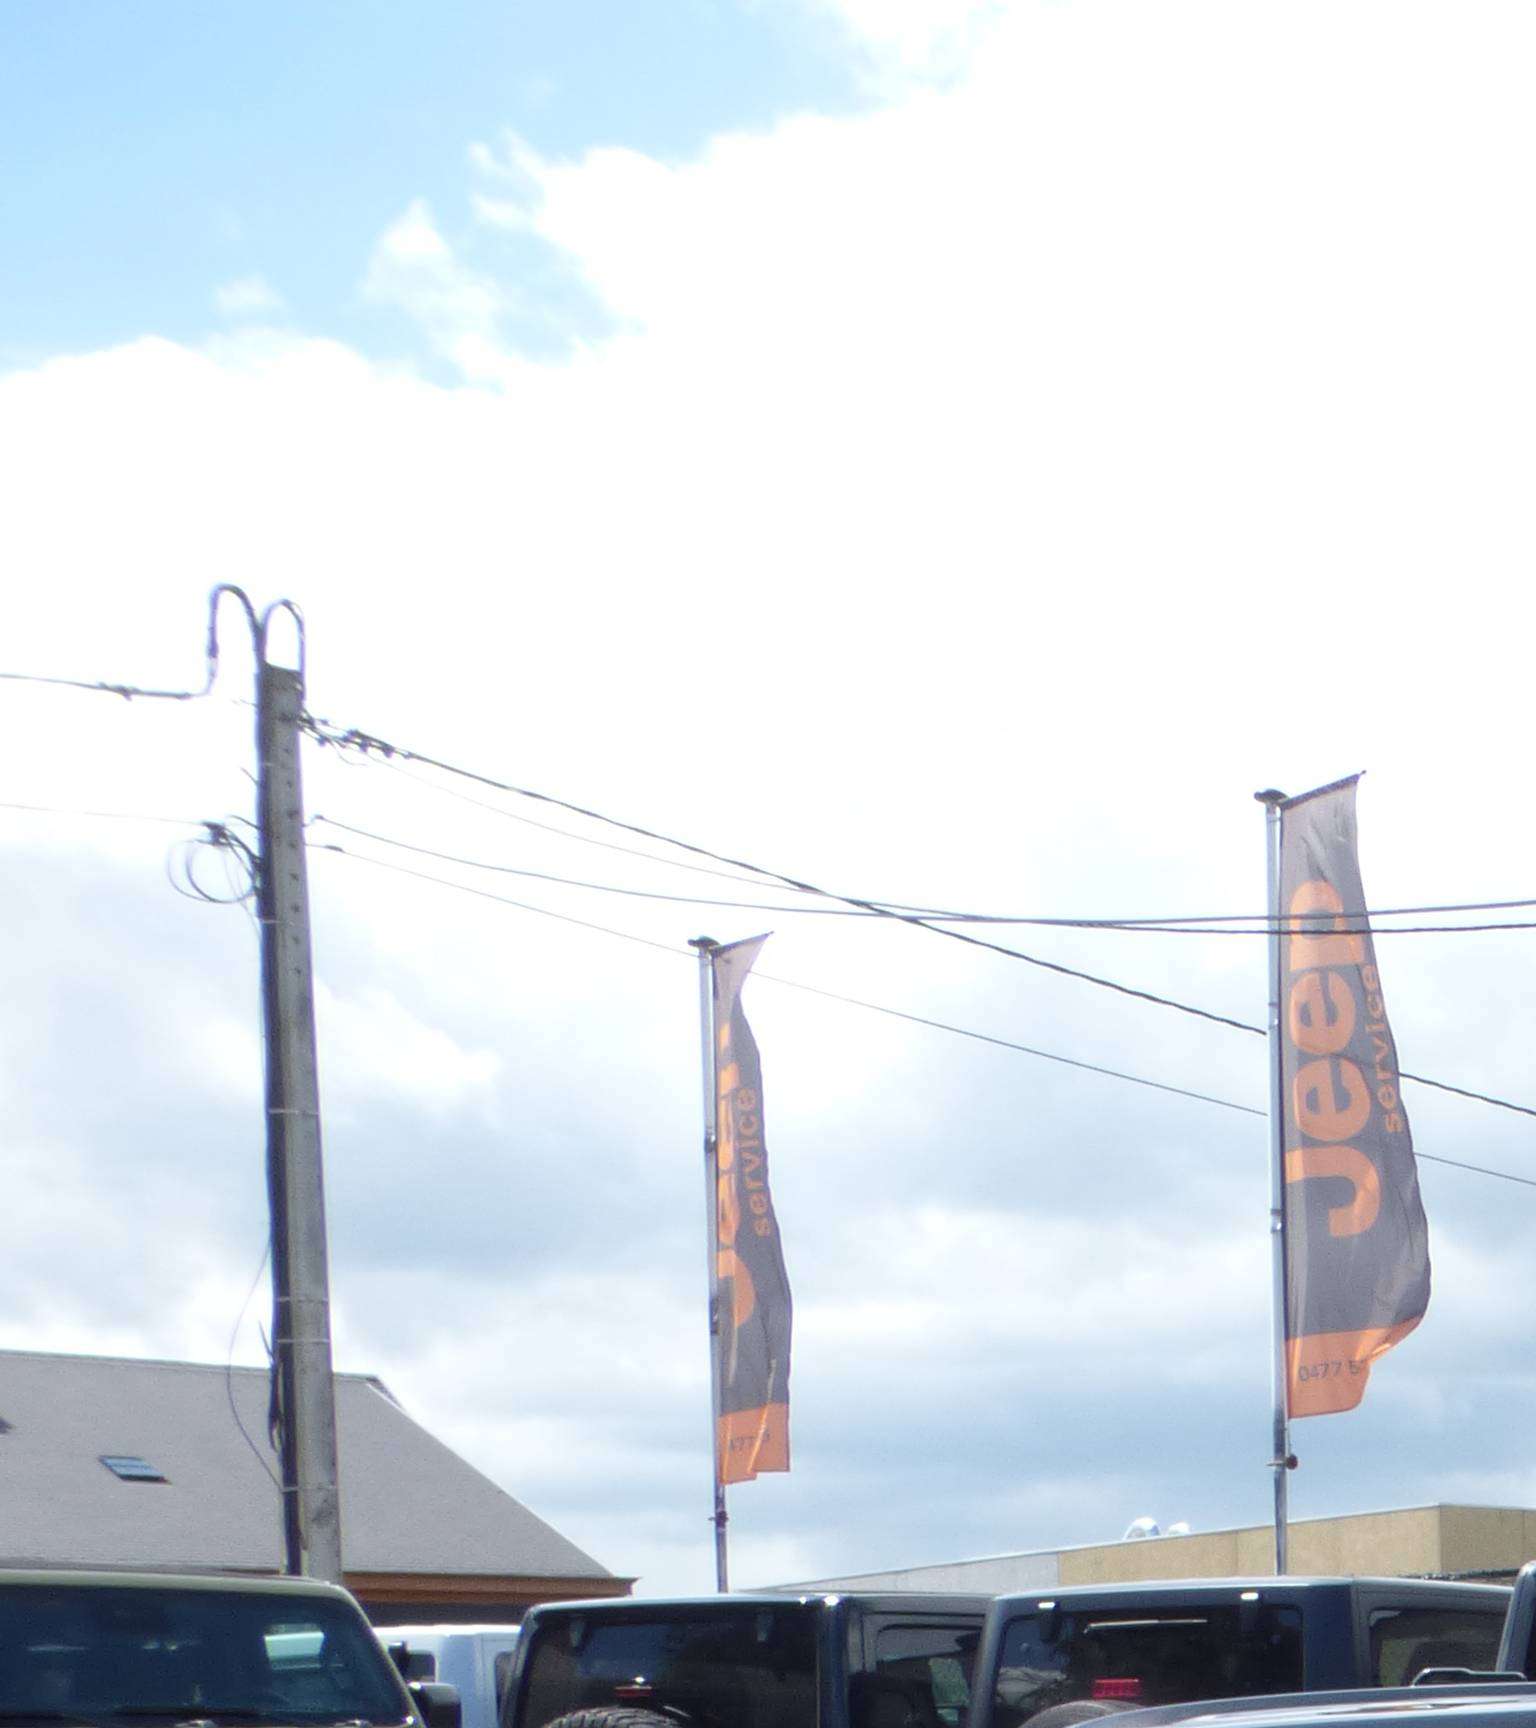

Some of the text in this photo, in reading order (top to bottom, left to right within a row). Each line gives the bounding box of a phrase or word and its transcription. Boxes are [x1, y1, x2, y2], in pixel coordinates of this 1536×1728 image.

[1286, 880, 1381, 1237] Jeep
[1361, 963, 1404, 1134] service
[736, 1087, 771, 1238] service
